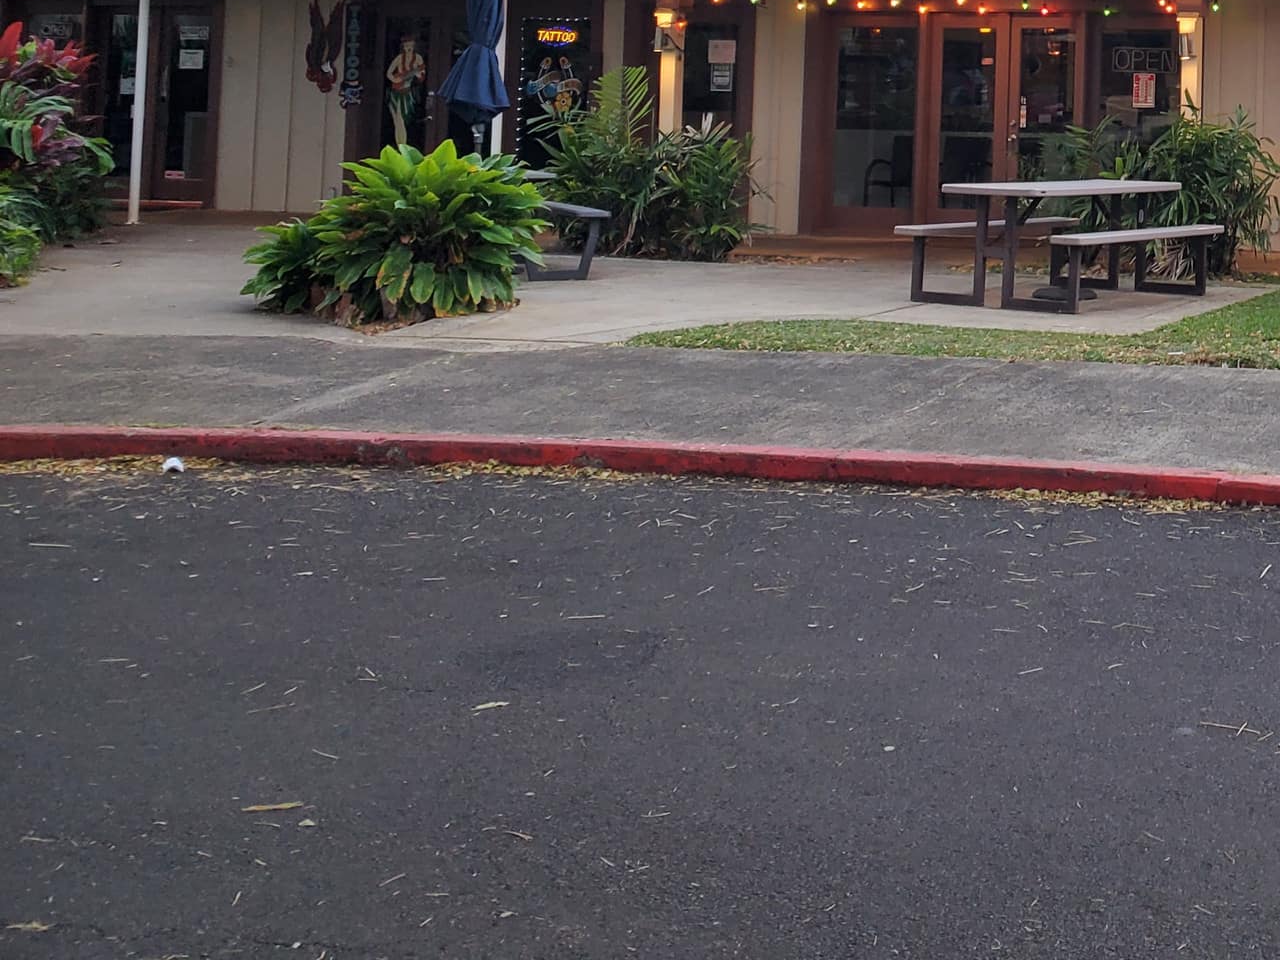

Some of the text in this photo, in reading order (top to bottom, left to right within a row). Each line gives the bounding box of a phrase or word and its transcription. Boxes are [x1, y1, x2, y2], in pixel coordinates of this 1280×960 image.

[345, 4, 360, 81] TATTOO
[537, 30, 577, 43] TATTOO
[1114, 49, 1176, 72] OPEN
